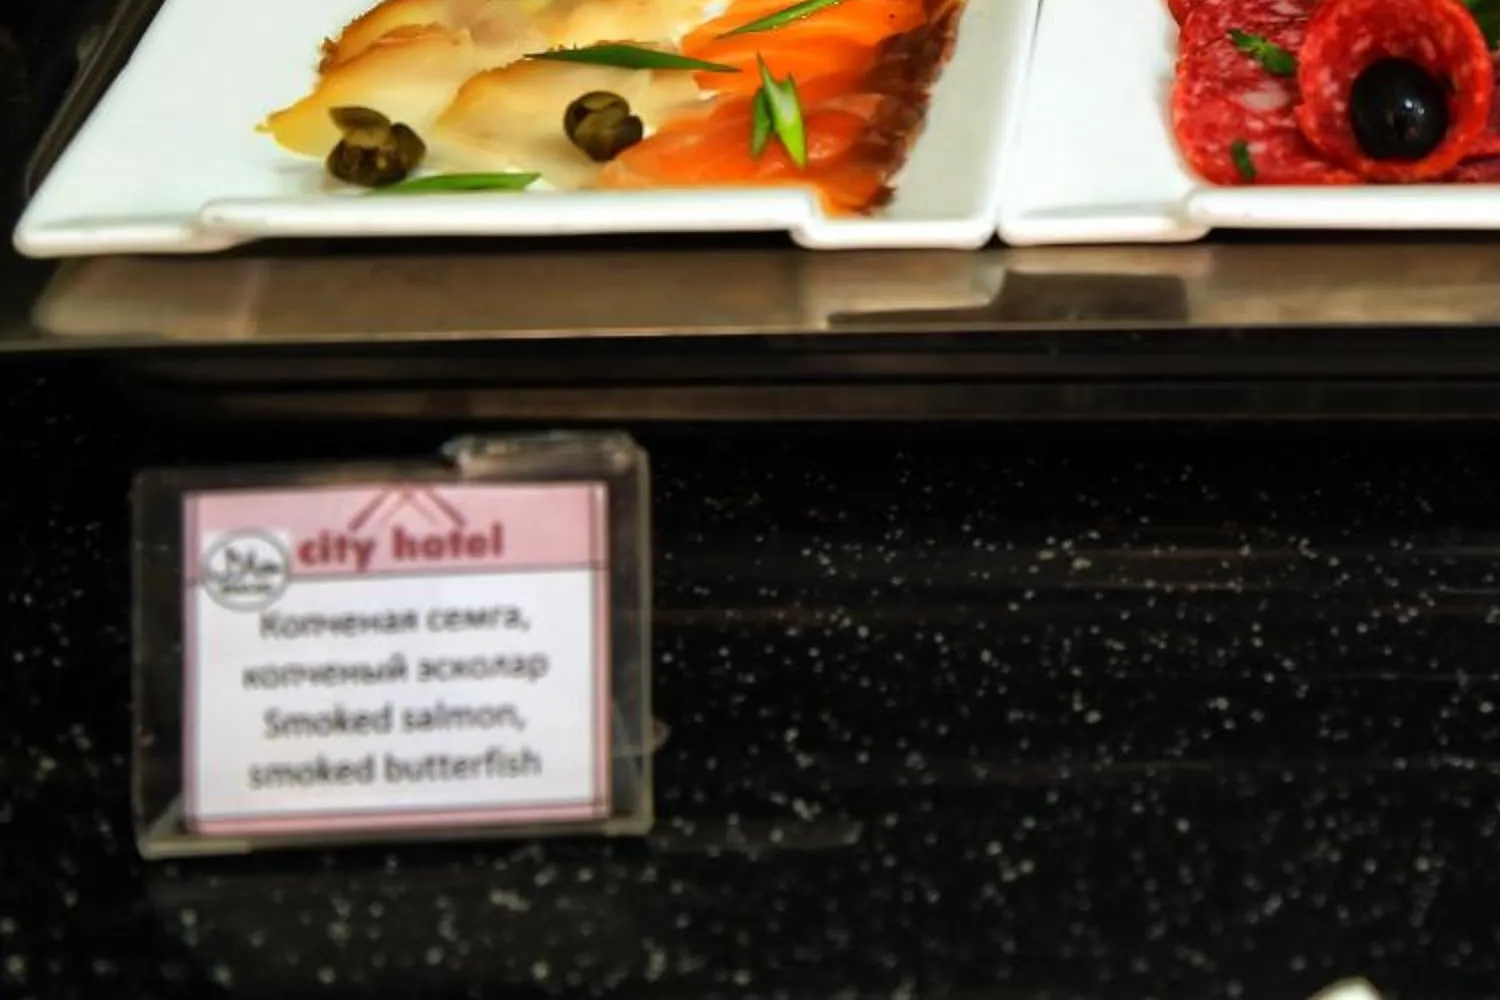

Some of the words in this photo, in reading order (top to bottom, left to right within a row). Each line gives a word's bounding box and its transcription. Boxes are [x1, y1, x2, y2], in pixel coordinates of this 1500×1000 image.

[297, 533, 375, 571] city
[391, 523, 504, 559] hotel
[259, 604, 418, 638] Копченая
[425, 602, 530, 632] семга,
[263, 701, 392, 738] Smoked
[401, 698, 526, 731] salmon,
[247, 752, 375, 789] smoked
[385, 746, 543, 780] butterfish
